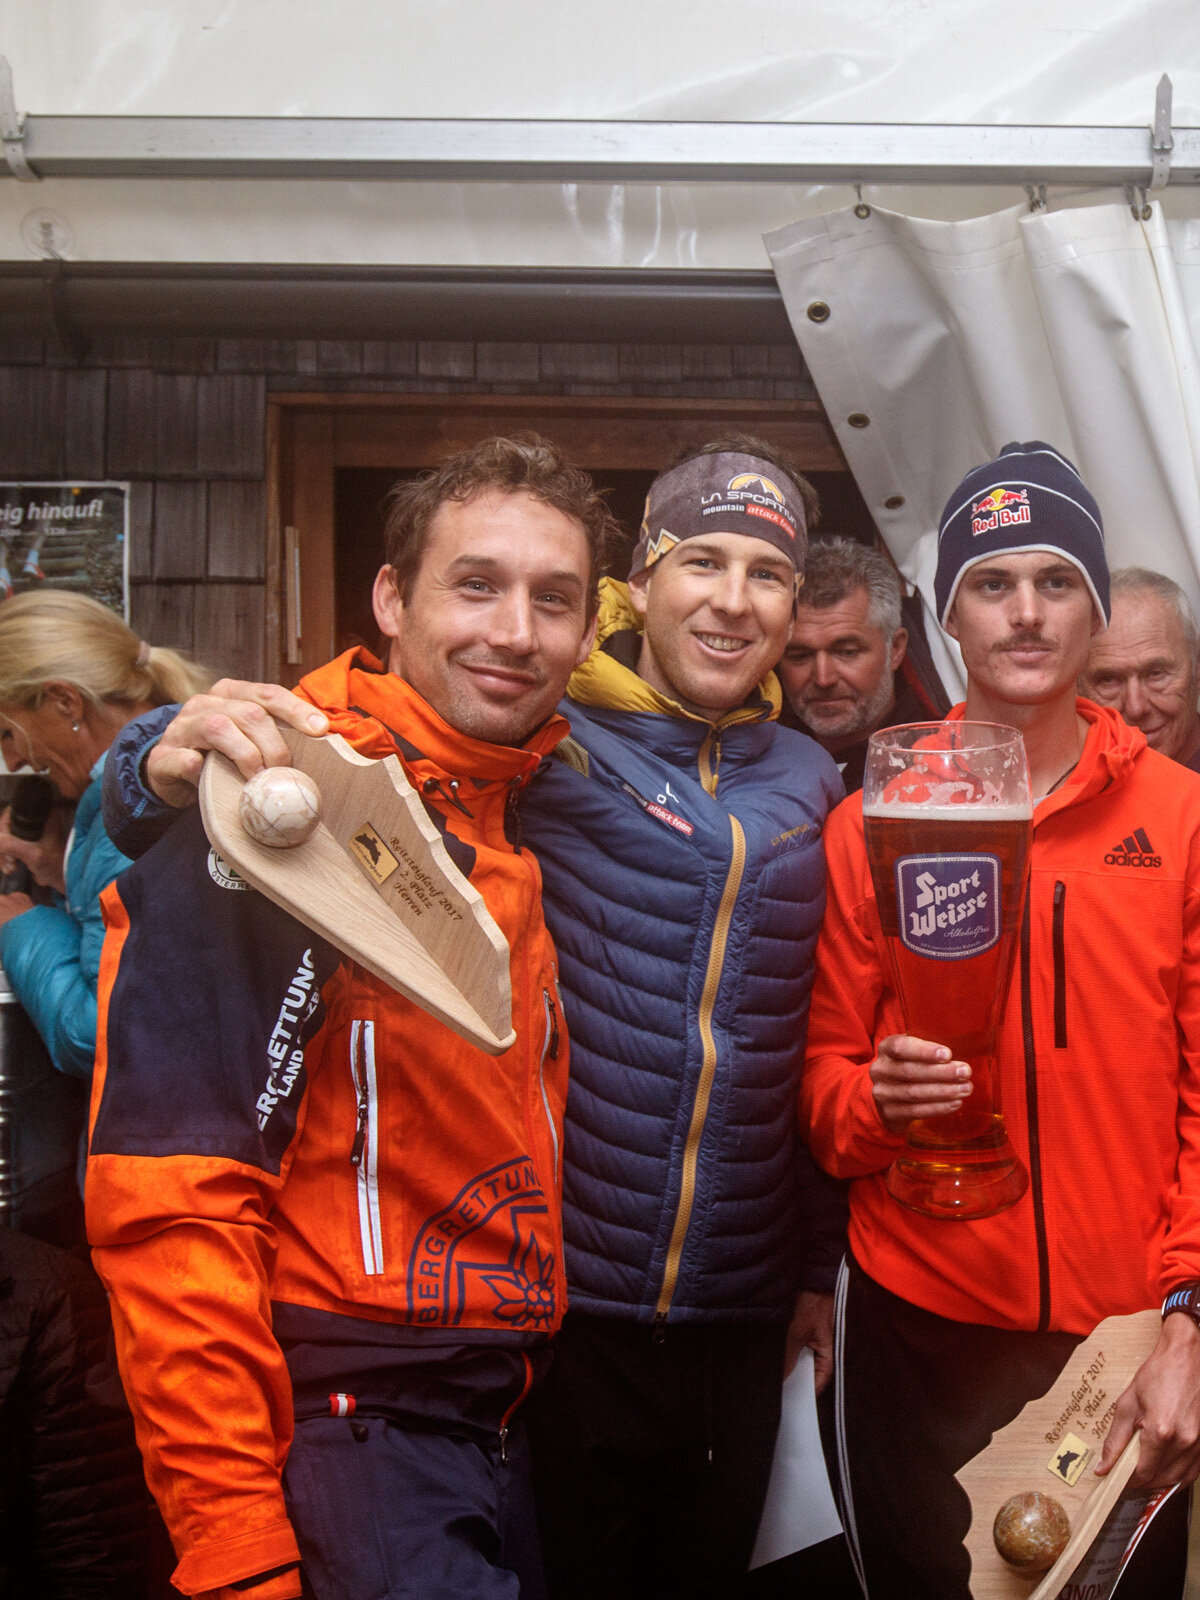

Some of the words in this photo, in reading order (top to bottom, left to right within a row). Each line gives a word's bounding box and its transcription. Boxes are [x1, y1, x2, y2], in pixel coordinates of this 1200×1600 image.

[27, 499, 104, 519] hinauf!
[703, 504, 745, 516] mountain
[747, 505, 779, 522] attack
[972, 511, 998, 536] Red
[1000, 505, 1031, 526] Bull
[648, 805, 672, 822] attack
[1104, 852, 1162, 868] adidas
[393, 882, 422, 916] Herren
[410, 881, 433, 909] Platz
[916, 869, 981, 909] Sport
[439, 897, 463, 921] 2017
[909, 891, 988, 937] Weisse
[277, 1049, 304, 1098] LAND
[1045, 1375, 1092, 1444] Reitsteiglauf
[1087, 1351, 1106, 1380] 2017
[1084, 1389, 1106, 1418] Platz
